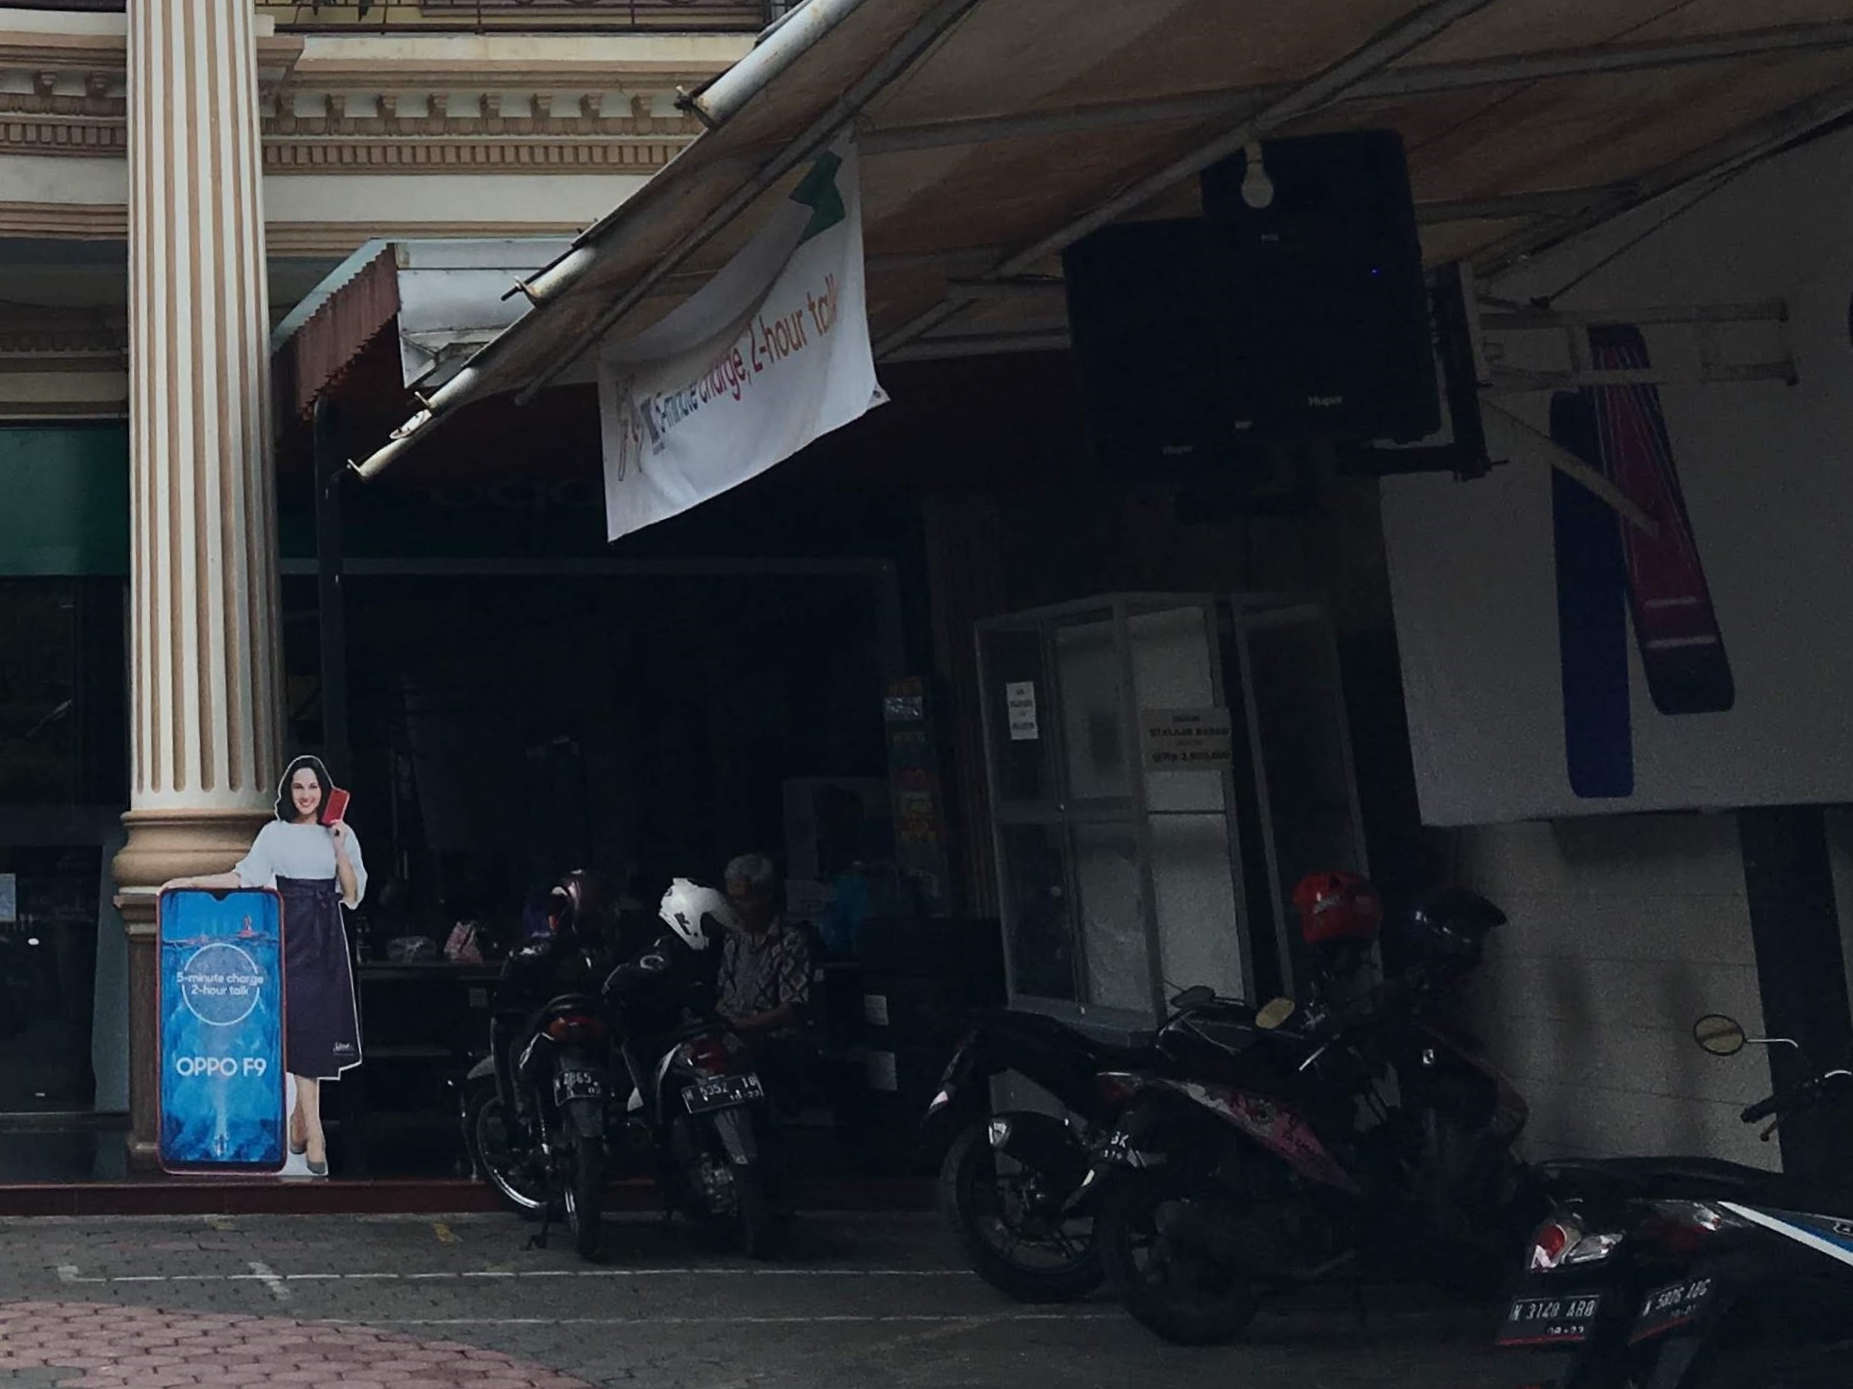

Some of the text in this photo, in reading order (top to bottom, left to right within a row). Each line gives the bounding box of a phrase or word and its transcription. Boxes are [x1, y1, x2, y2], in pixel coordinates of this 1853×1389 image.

[177, 972, 264, 986] 5-minute charge
[192, 984, 248, 995] 2-hour talk
[176, 1057, 266, 1077] OPPO F9
